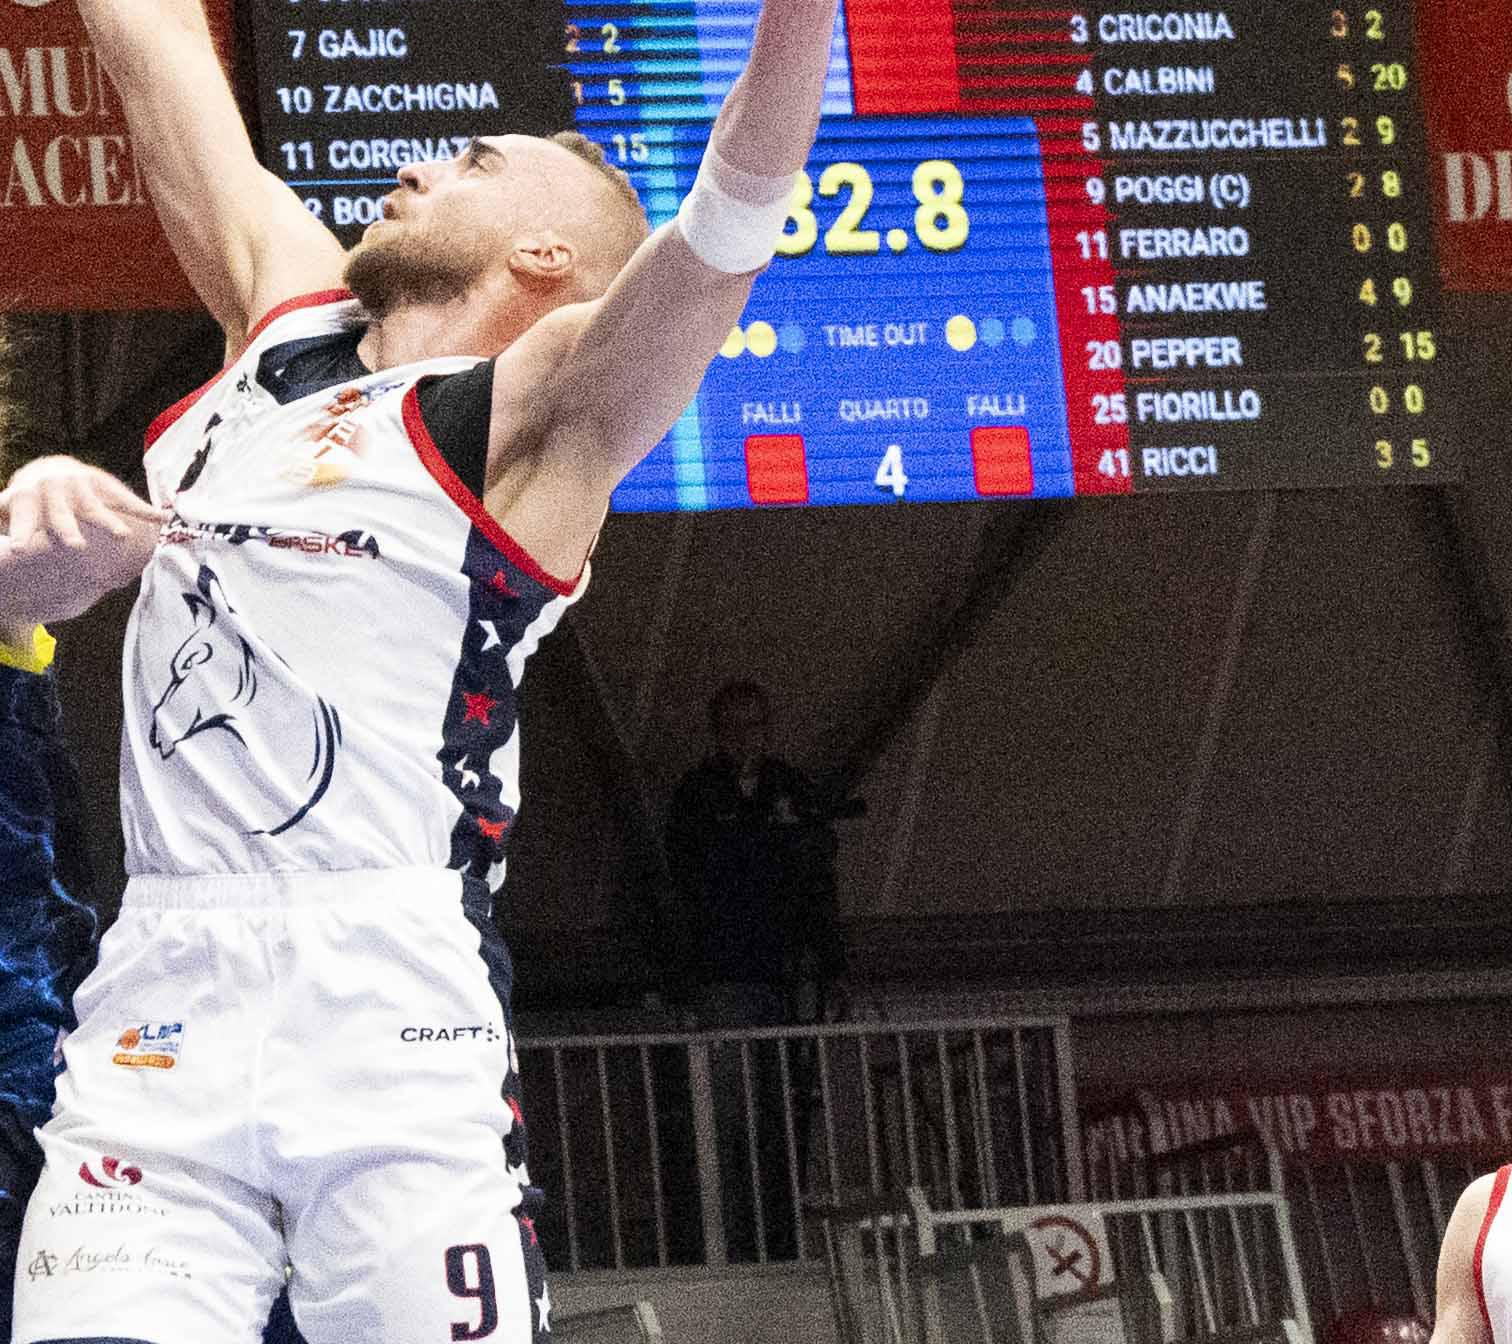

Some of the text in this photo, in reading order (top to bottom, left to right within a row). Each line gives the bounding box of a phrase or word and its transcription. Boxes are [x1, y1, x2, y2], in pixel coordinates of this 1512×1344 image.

[288, 30, 306, 58] 7
[319, 28, 407, 57] GAJIC
[602, 24, 621, 53] 2
[1070, 15, 1089, 44] 3
[1098, 11, 1235, 43] CRICONIA
[1364, 10, 1385, 40] 2
[276, 86, 312, 114] 10
[323, 81, 499, 113] ZACCHIGNA
[608, 79, 625, 106] 5
[1075, 70, 1093, 96] 4
[1104, 67, 1215, 95] CALBINI
[1371, 62, 1407, 91] 20
[1083, 115, 1395, 151] 5 MAZZUCCHELLI 2 9
[281, 142, 314, 170] 11
[613, 134, 647, 162] 15
[1086, 169, 1402, 209] 9 POGGI (C) 8
[1076, 222, 1408, 260] 11 FERRARO 0 0
[1081, 277, 1413, 316] 15 ANAEKWE 4 9
[821, 321, 928, 346] TIME OUT
[1086, 332, 1437, 370] 20 PEPPER 2 15
[741, 394, 1025, 425] FALLI QUARTO FALLI
[1091, 385, 1424, 424] 25 FIORILLO 0 0
[875, 444, 908, 496] 4
[1097, 439, 1431, 478] 41 RICCI 3 5
[401, 1026, 482, 1042] CRAFT
[1249, 1094, 1315, 1152] VIP
[1326, 1088, 1483, 1149] SFORZA
[444, 1243, 498, 1341] 9
